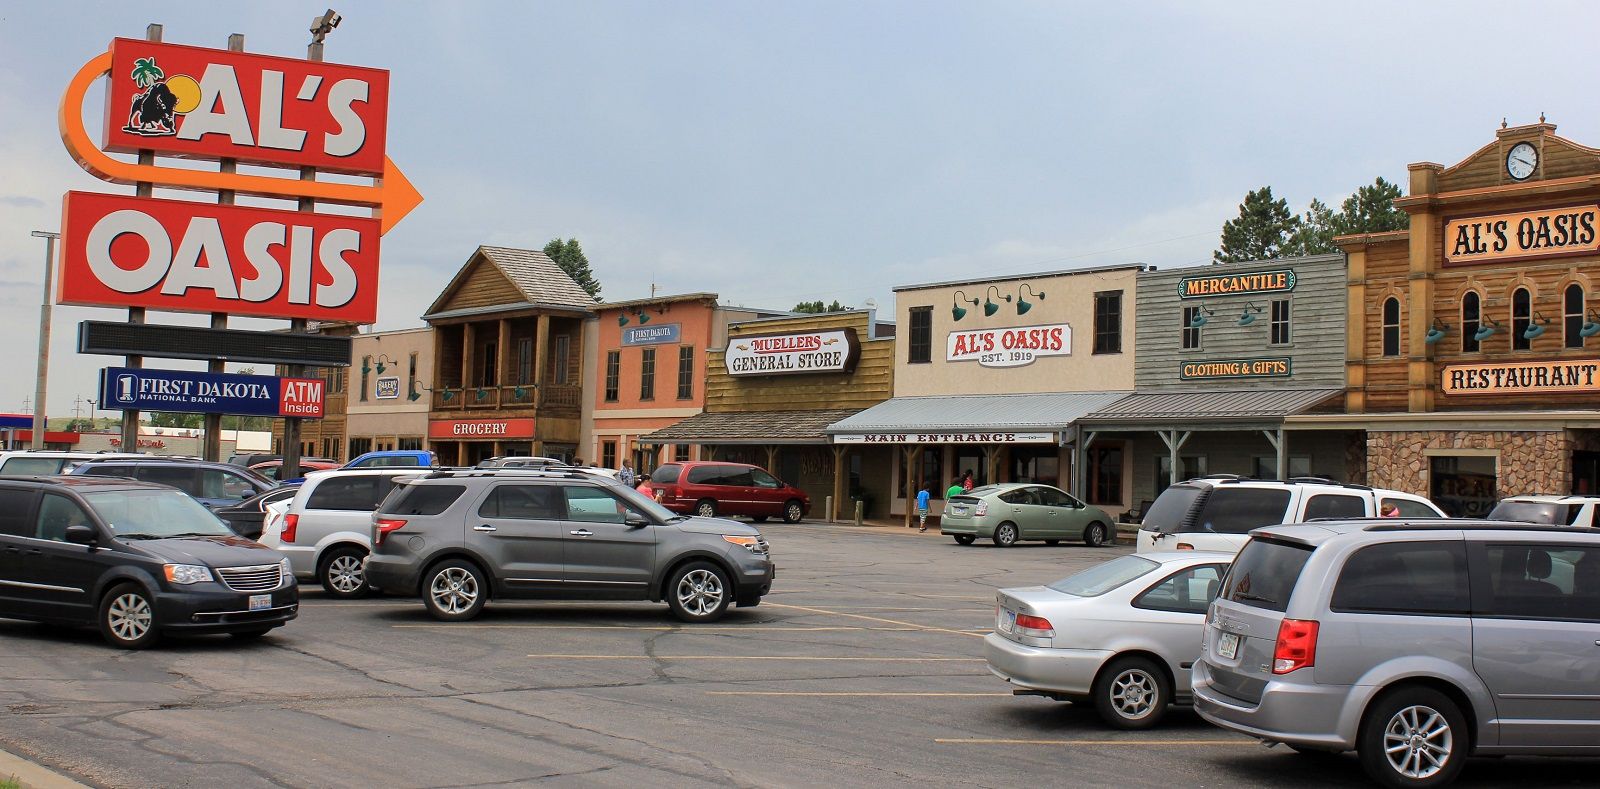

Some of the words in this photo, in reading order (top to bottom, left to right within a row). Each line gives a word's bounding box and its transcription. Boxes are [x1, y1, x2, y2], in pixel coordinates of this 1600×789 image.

[176, 62, 369, 157] AL'S
[1452, 220, 1508, 256] AL'S
[1517, 211, 1595, 250] OASIS
[86, 209, 361, 308] OASIS
[1186, 273, 1286, 295] MERCANTILE
[650, 327, 671, 337] DAKOTA
[952, 331, 995, 357] AL'S
[1001, 328, 1063, 351] OASIS
[751, 335, 822, 351] MUELLERS
[733, 354, 794, 372] GENERAL
[798, 351, 842, 369] STORE
[981, 353, 1005, 363] EST.
[1009, 351, 1033, 361] 1919
[1184, 362, 1239, 377] CLOTHING
[1242, 363, 1250, 375] &
[1252, 361, 1286, 374] GIFTS
[1450, 364, 1597, 390] RESTAURANT
[139, 377, 194, 396] FIRST
[198, 380, 271, 400] DAKOTA
[140, 393, 188, 402] NATIONAL
[191, 396, 217, 404] BANK
[283, 381, 322, 403] ATM
[285, 402, 319, 414] Inside
[453, 421, 508, 436] GROCERY
[863, 433, 908, 443] MAIN
[917, 433, 1016, 443] ENTRANCE
